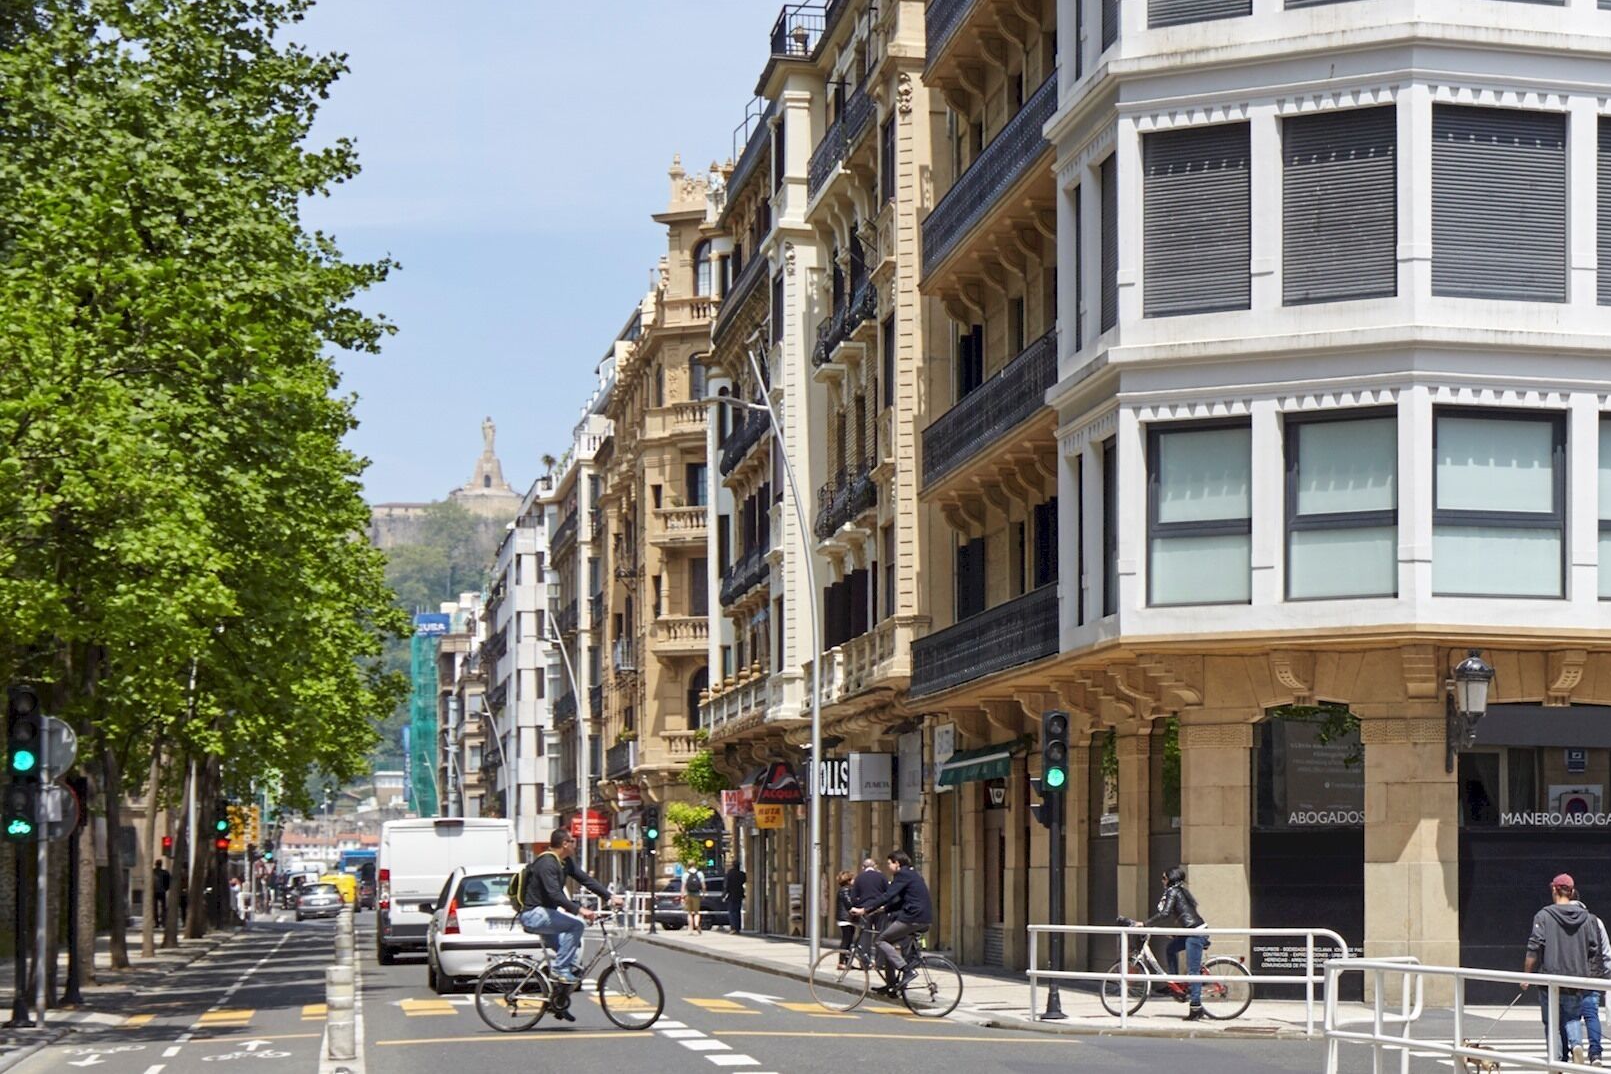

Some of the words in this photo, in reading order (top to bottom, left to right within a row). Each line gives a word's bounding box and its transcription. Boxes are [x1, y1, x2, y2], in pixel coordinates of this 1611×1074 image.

[762, 789, 800, 799] ACQUA
[757, 807, 781, 816] RUTA
[1501, 812, 1562, 826] MANERO
